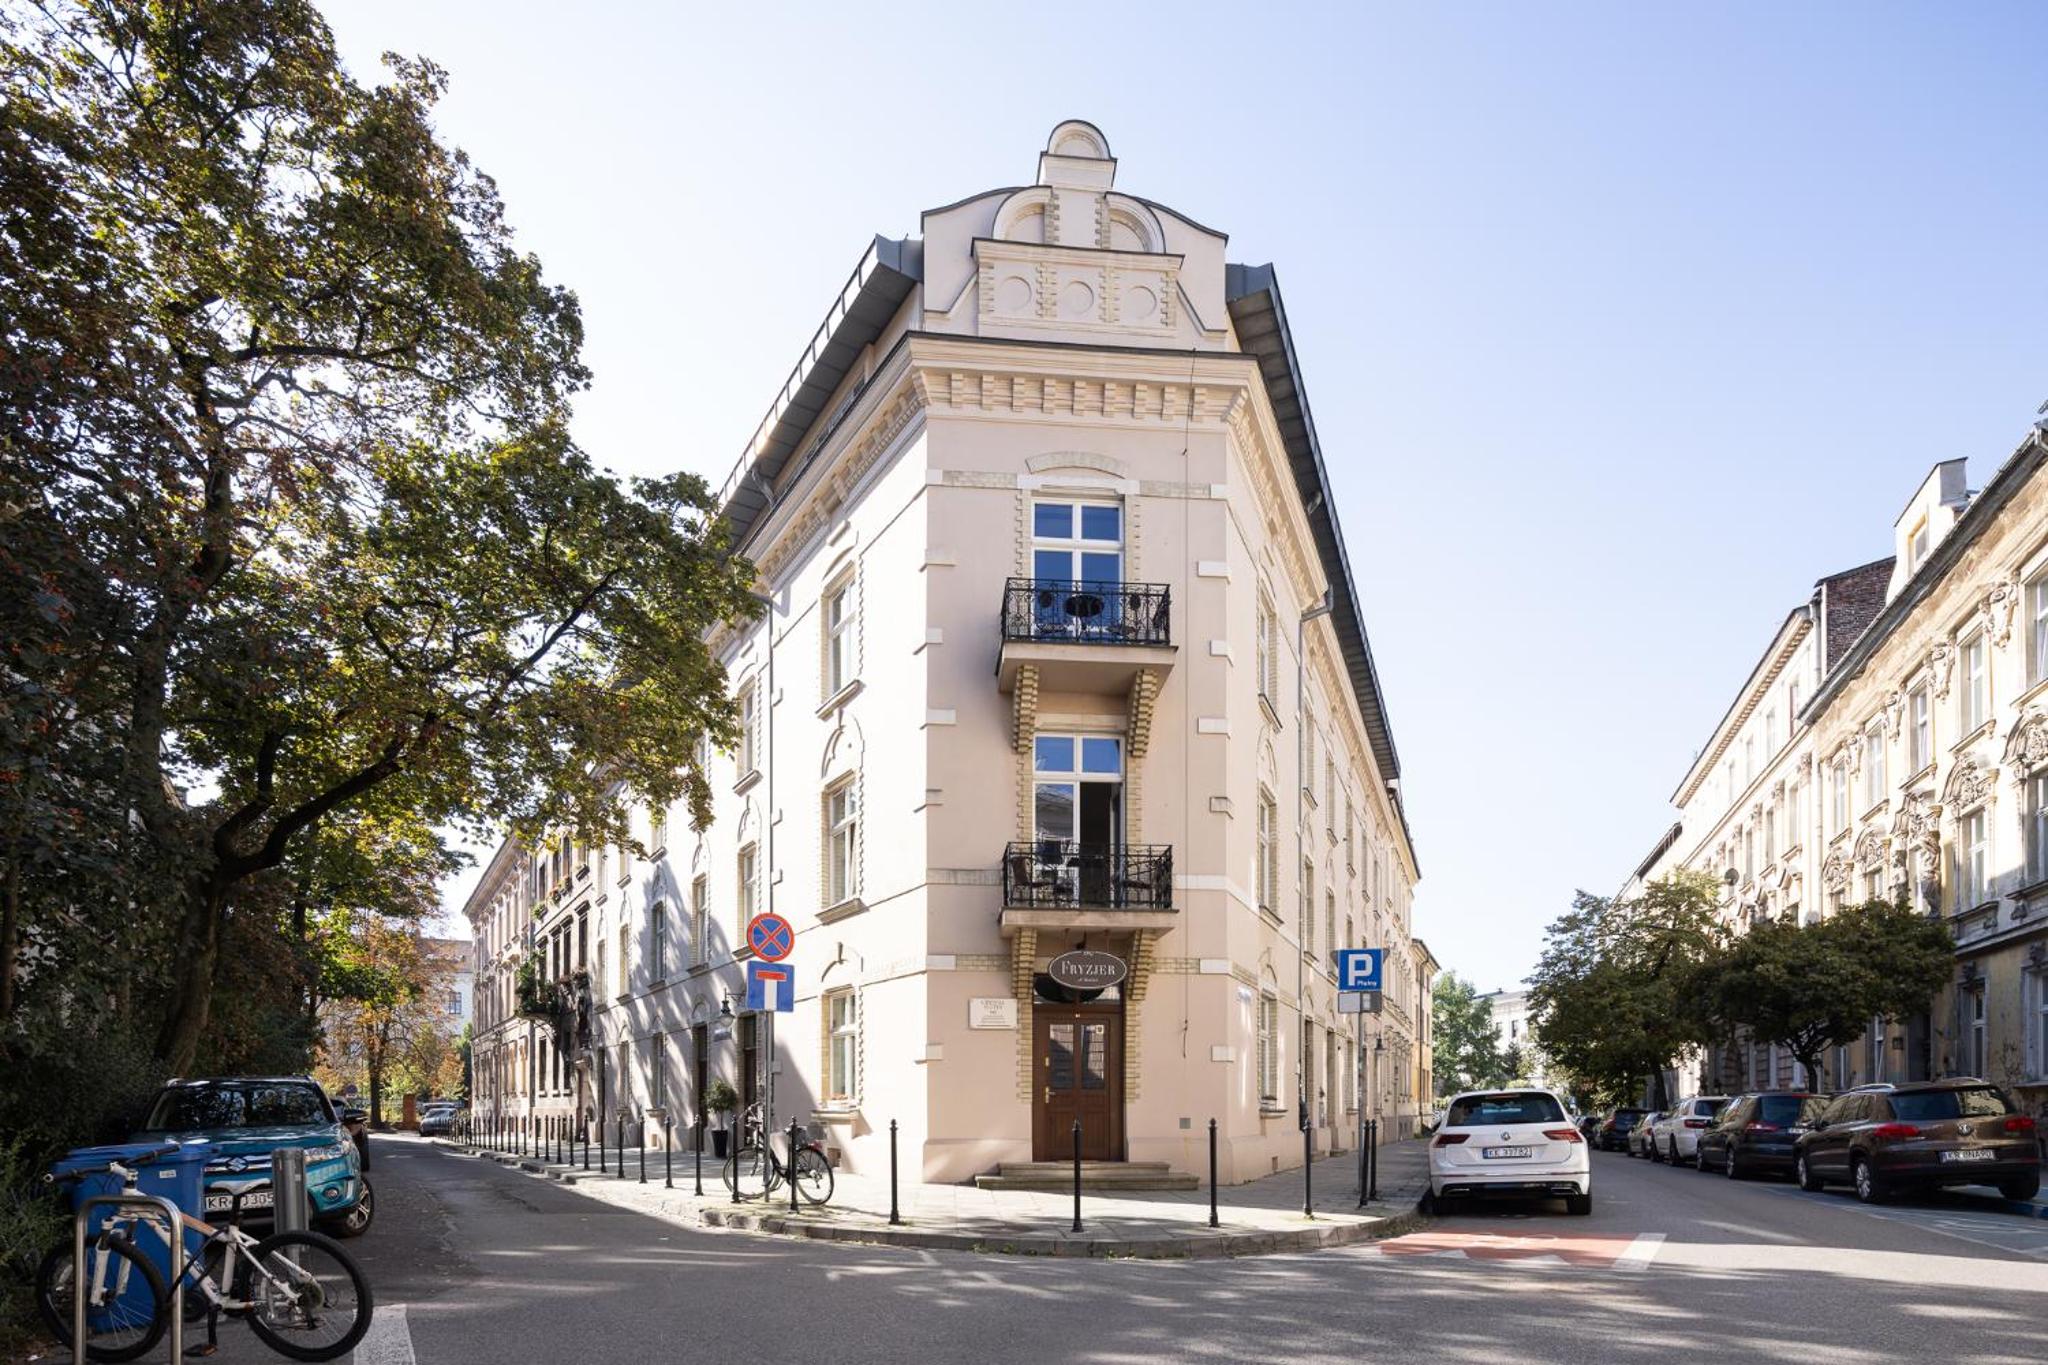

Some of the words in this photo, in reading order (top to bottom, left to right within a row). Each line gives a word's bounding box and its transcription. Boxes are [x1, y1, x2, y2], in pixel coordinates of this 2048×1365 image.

[1061, 960, 1116, 976] FRYZJER
[1348, 953, 1373, 986] P
[207, 1196, 229, 1209] KR
[241, 1192, 275, 1207] J305
